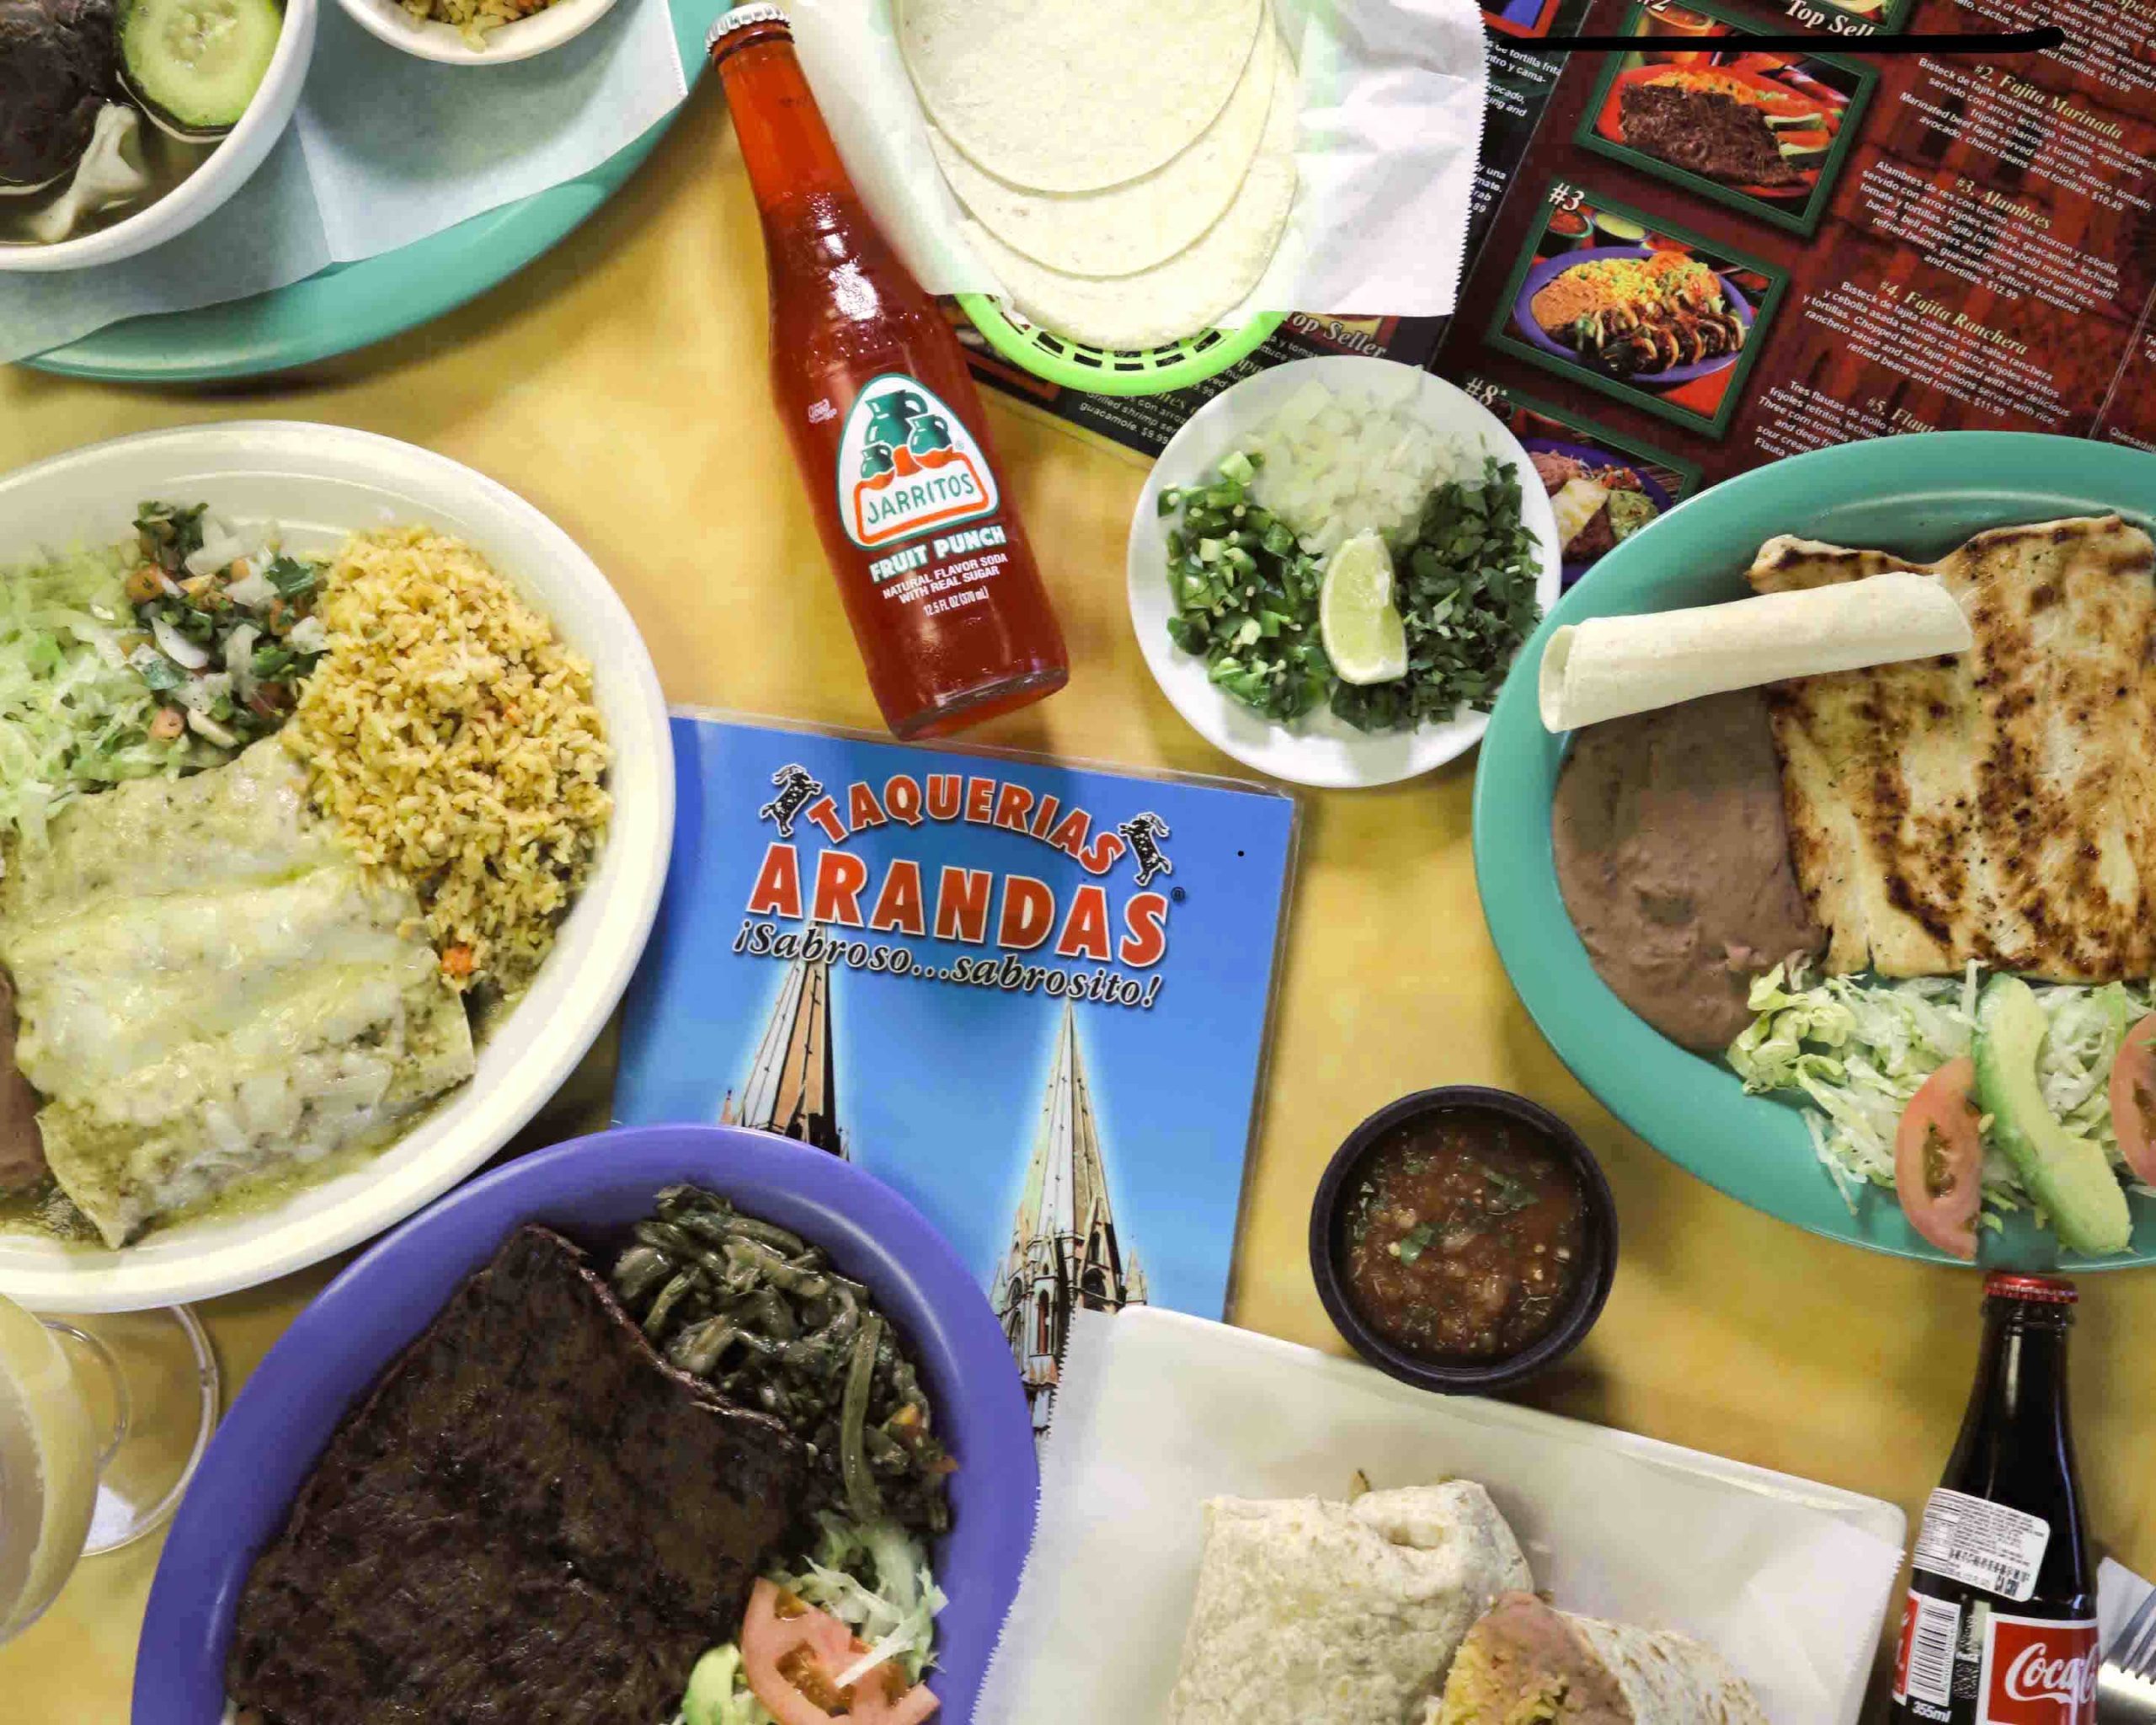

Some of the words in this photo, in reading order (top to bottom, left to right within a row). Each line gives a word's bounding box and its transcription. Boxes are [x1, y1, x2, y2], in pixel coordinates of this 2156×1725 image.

[1785, 0, 1825, 28] Top
[1505, 104, 1527, 116] and
[1998, 74, 2046, 104] Fajita
[2051, 96, 2122, 139] Marinada
[1486, 167, 1506, 179] una
[1548, 182, 1585, 211] #3
[1978, 190, 2049, 229] Alambres
[1322, 318, 1386, 361] Seller
[1903, 291, 1951, 321] Fajita
[1951, 312, 2027, 355] Ranchera
[1891, 408, 1935, 433] Flau
[867, 473, 975, 525] JARRITOS
[869, 544, 928, 584] FRUIT
[933, 525, 1007, 559] PUNCH
[883, 575, 931, 599] NATURAL
[934, 559, 977, 580] FLAVOR
[980, 553, 1008, 567] SODA
[899, 588, 930, 604] WITH
[931, 577, 961, 594] REAL
[963, 565, 1000, 583] SUGAR
[806, 774, 1126, 874] TAQUERIAS
[746, 841, 1169, 968] ARANDAS
[1912, 1701, 1952, 1723] 355ml
